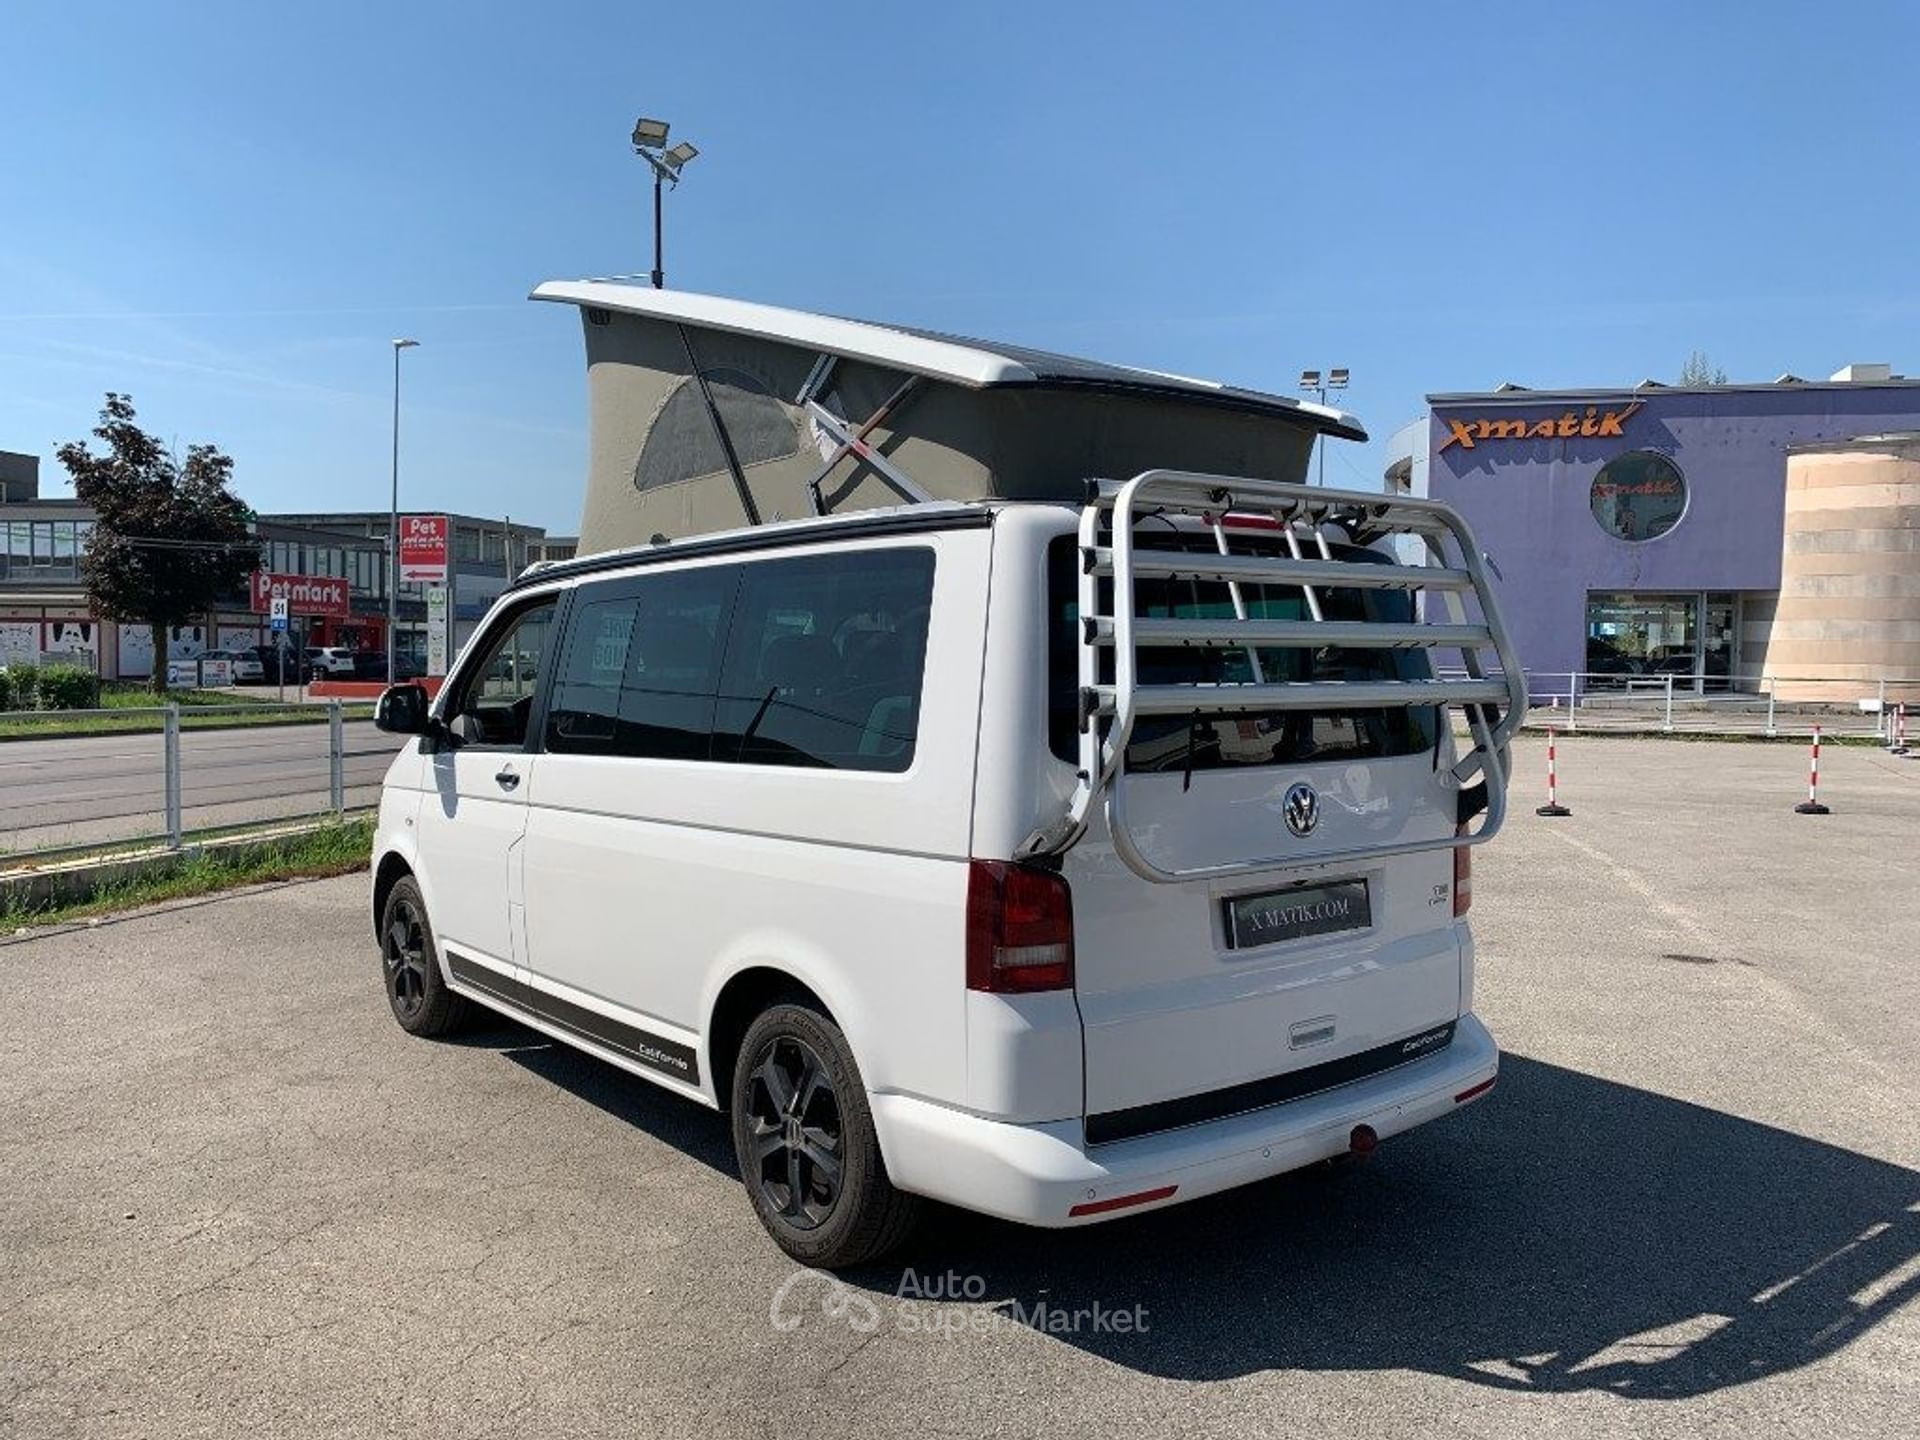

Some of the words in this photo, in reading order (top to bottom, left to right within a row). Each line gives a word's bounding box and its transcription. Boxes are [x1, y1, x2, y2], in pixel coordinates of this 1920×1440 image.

[410, 519, 437, 534] Pet
[403, 535, 444, 549] mark
[258, 574, 341, 603] Petmark
[640, 1043, 688, 1070] California
